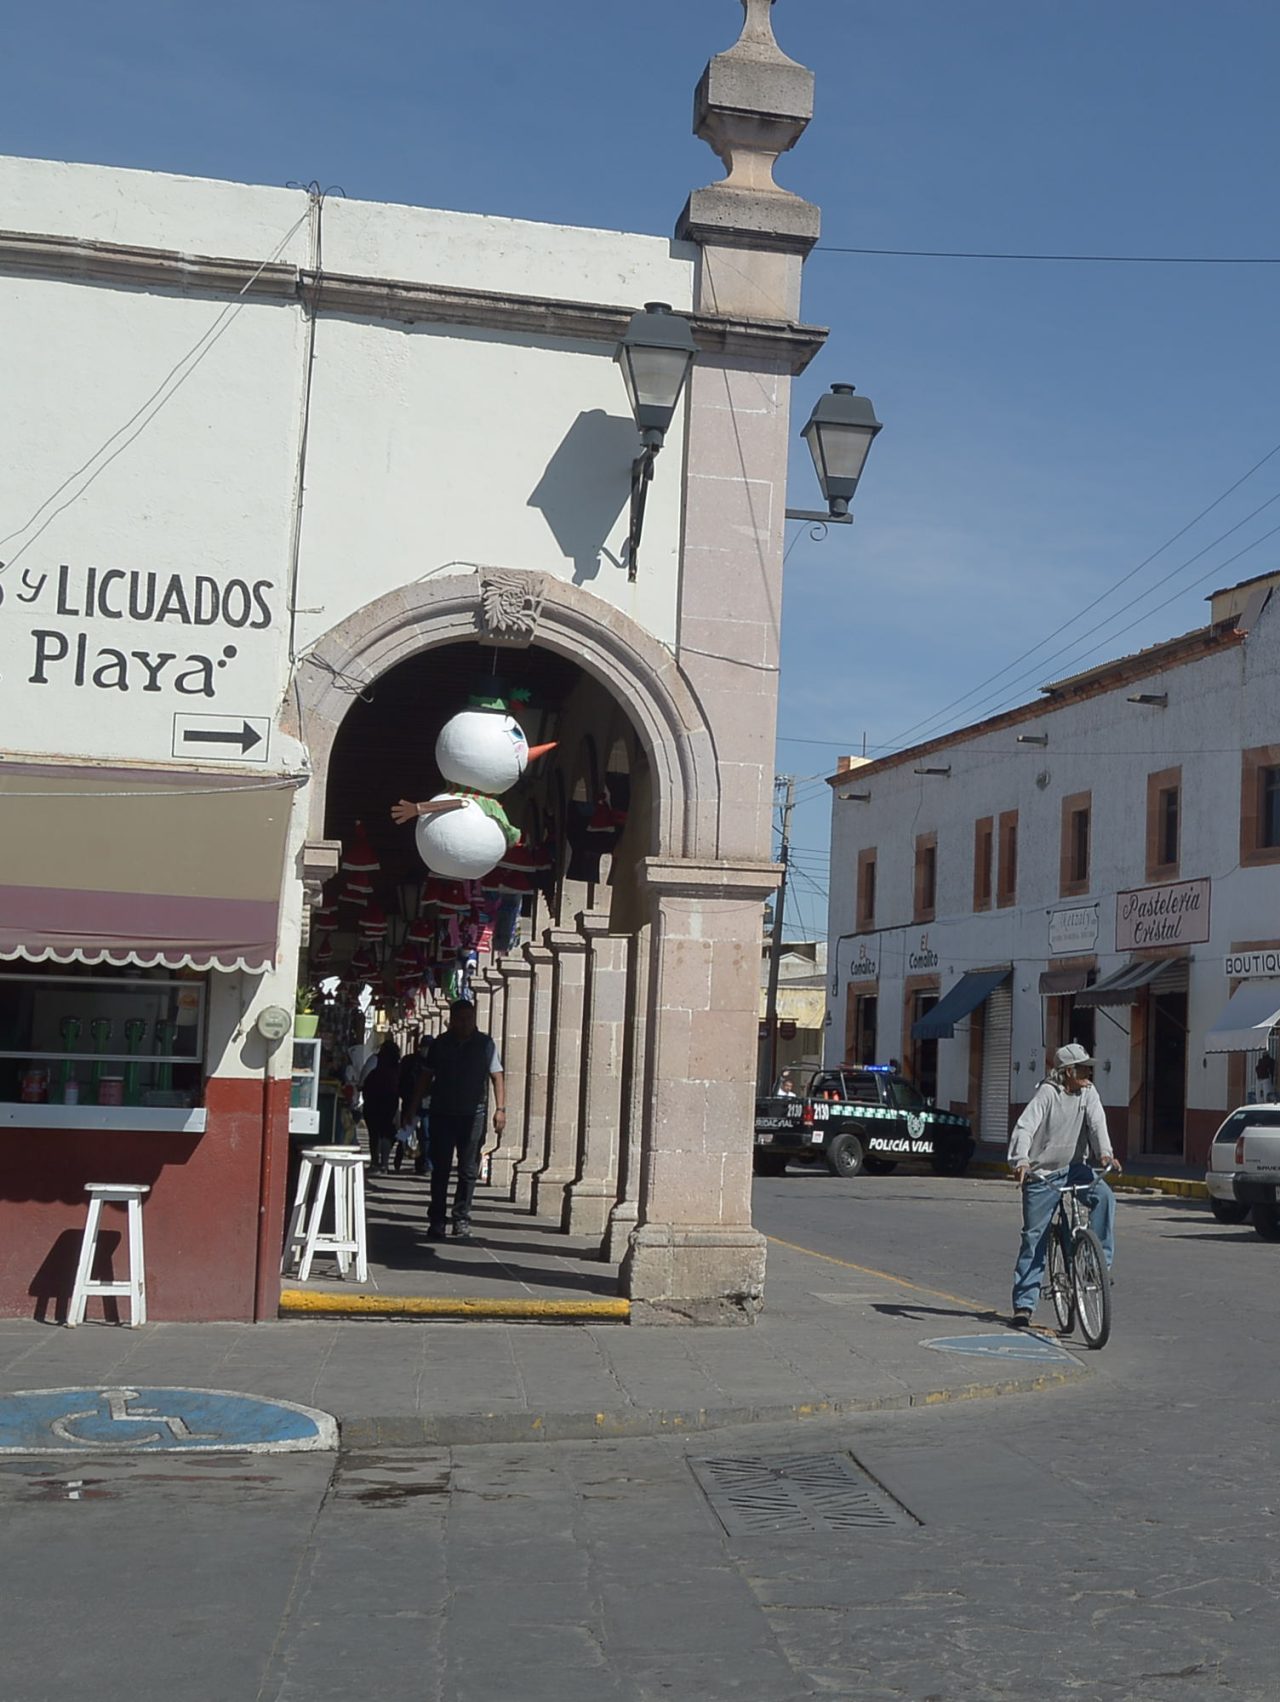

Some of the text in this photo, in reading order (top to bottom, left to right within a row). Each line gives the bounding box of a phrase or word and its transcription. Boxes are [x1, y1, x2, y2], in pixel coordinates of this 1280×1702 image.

[16, 568, 48, 603] y
[57, 565, 275, 629] LICUADOS
[28, 629, 215, 698] Playa
[1134, 915, 1182, 944] Cristal
[814, 1102, 829, 1120] 2130
[869, 1138, 935, 1153] POLICÍA VIAL
